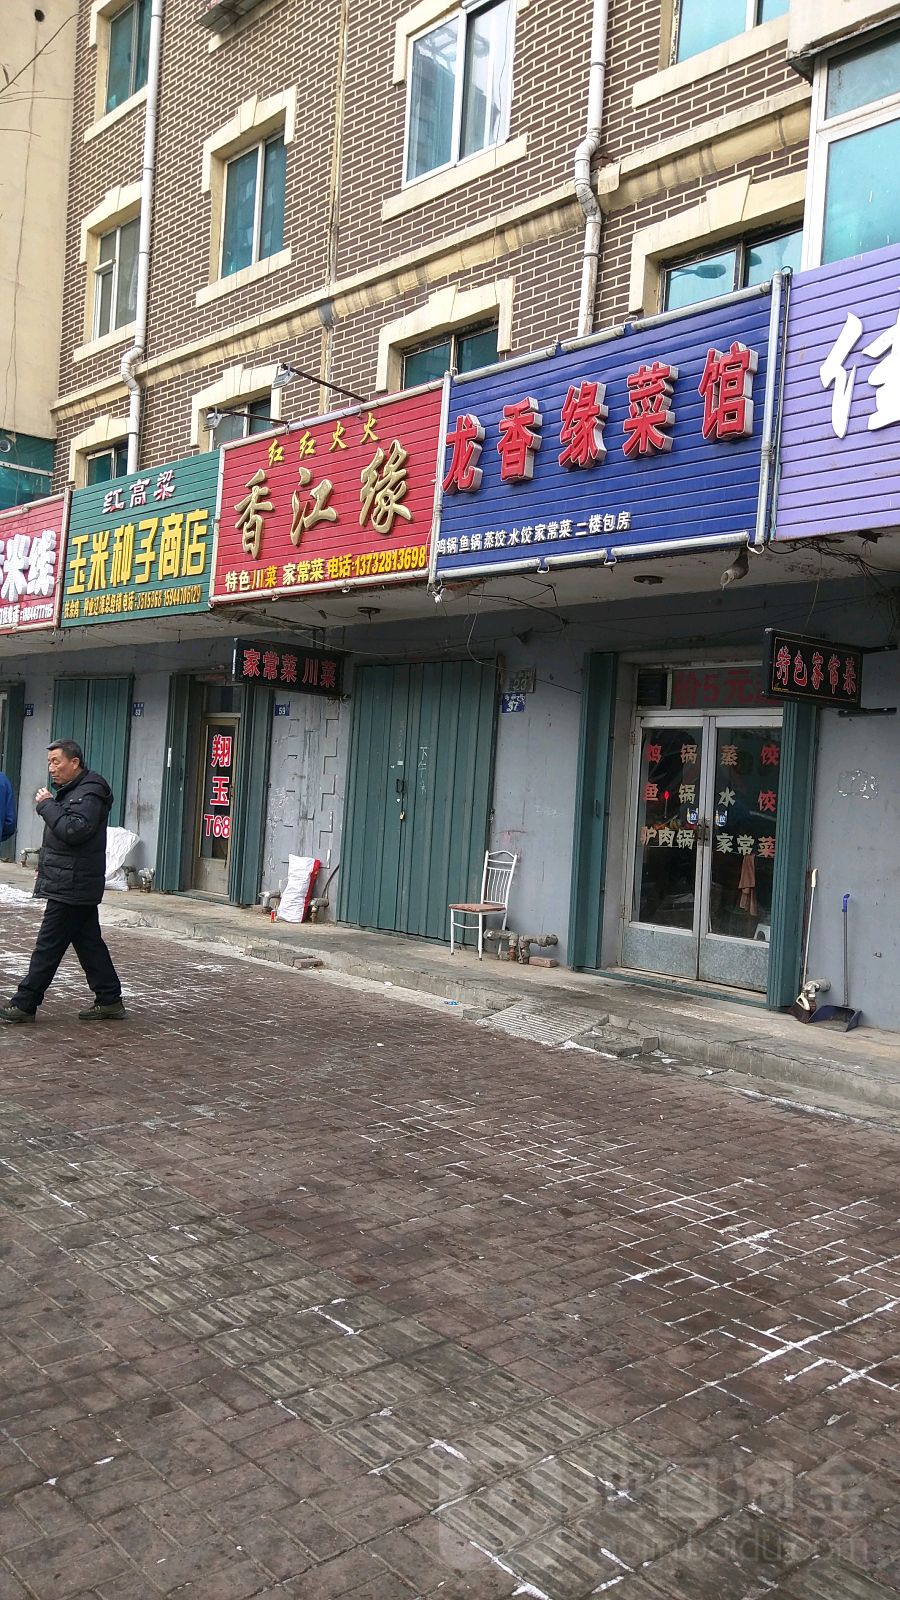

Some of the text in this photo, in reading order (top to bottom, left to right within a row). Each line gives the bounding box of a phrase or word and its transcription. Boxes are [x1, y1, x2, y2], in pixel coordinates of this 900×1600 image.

[268, 412, 380, 467] 红红火火
[442, 341, 759, 494] 龙香缘菜馆
[234, 439, 413, 559] 香江缘
[67, 509, 209, 595] 玉米种子商店
[776, 645, 857, 695] 特色家常菜
[204, 814, 231, 838] T68
[716, 832, 777, 858] 家常菜
